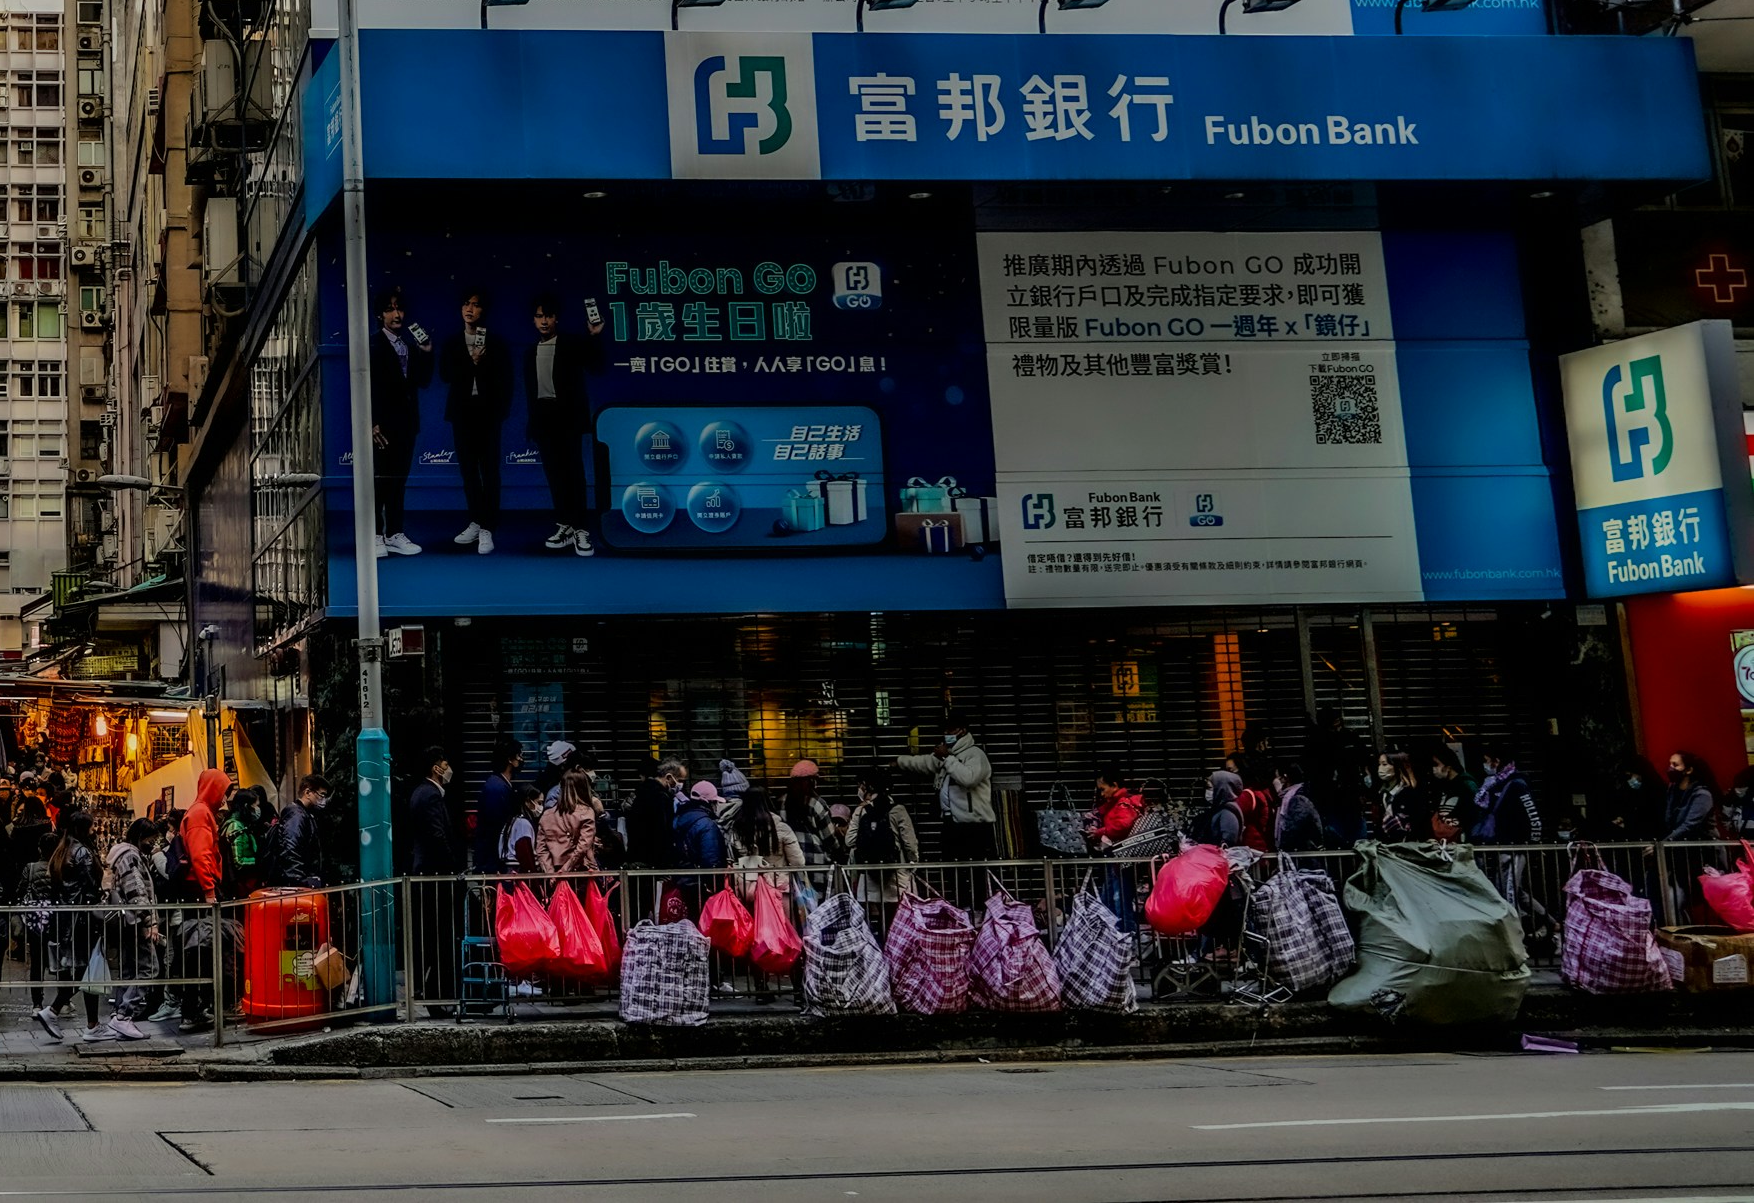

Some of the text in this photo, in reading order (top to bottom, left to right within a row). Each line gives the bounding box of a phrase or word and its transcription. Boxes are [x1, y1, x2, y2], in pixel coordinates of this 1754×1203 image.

[848, 72, 1419, 146] 富邦銀行 Fubon Bank
[605, 260, 817, 296] Fubon GO
[1153, 255, 1235, 275] Fubon
[1245, 255, 1283, 275] GO
[1293, 252, 1362, 276] 成功開
[609, 301, 813, 342] 1歲生日啦
[1009, 315, 1079, 339] 限量版
[1085, 317, 1162, 337] Fubon
[1167, 317, 1205, 337] GO
[789, 424, 863, 443] 自己生活
[1088, 491, 1161, 504] Fubon Bank
[1063, 505, 1163, 530] 富邦銀行
[1602, 506, 1701, 555] 富邦銀行
[1607, 550, 1705, 585] Fubon Bank
[1519, 792, 1543, 842] HOLLISTER
